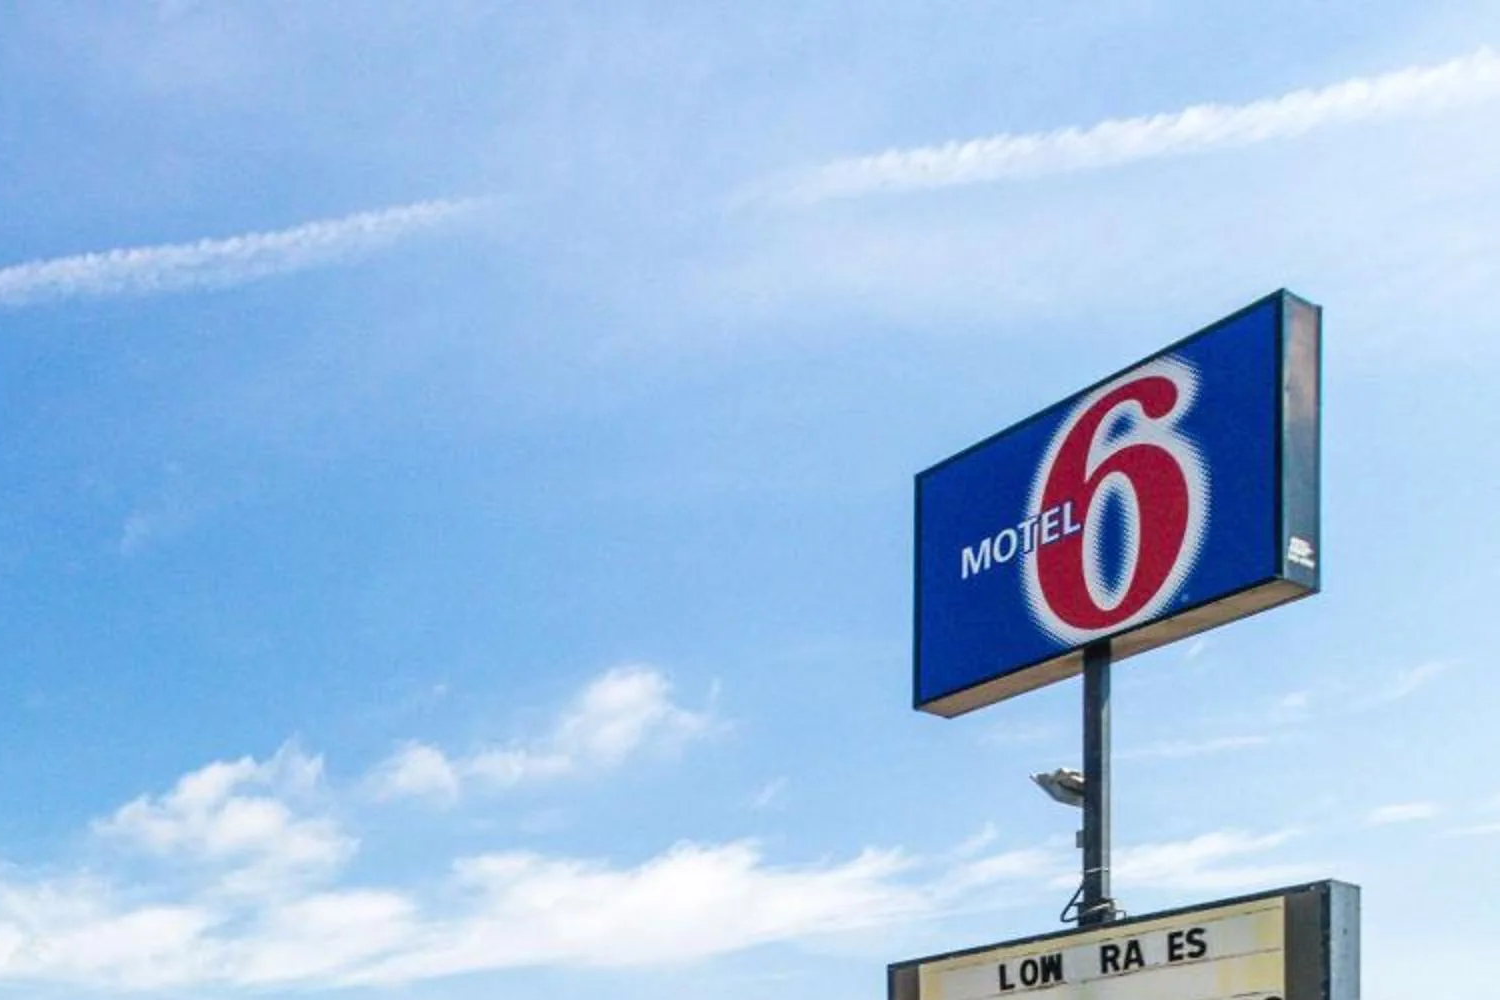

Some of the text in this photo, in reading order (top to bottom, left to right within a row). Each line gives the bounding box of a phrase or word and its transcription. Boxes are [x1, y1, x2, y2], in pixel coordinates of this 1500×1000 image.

[961, 375, 1190, 631] MOTEL 6
[1000, 953, 1062, 991] LOW
